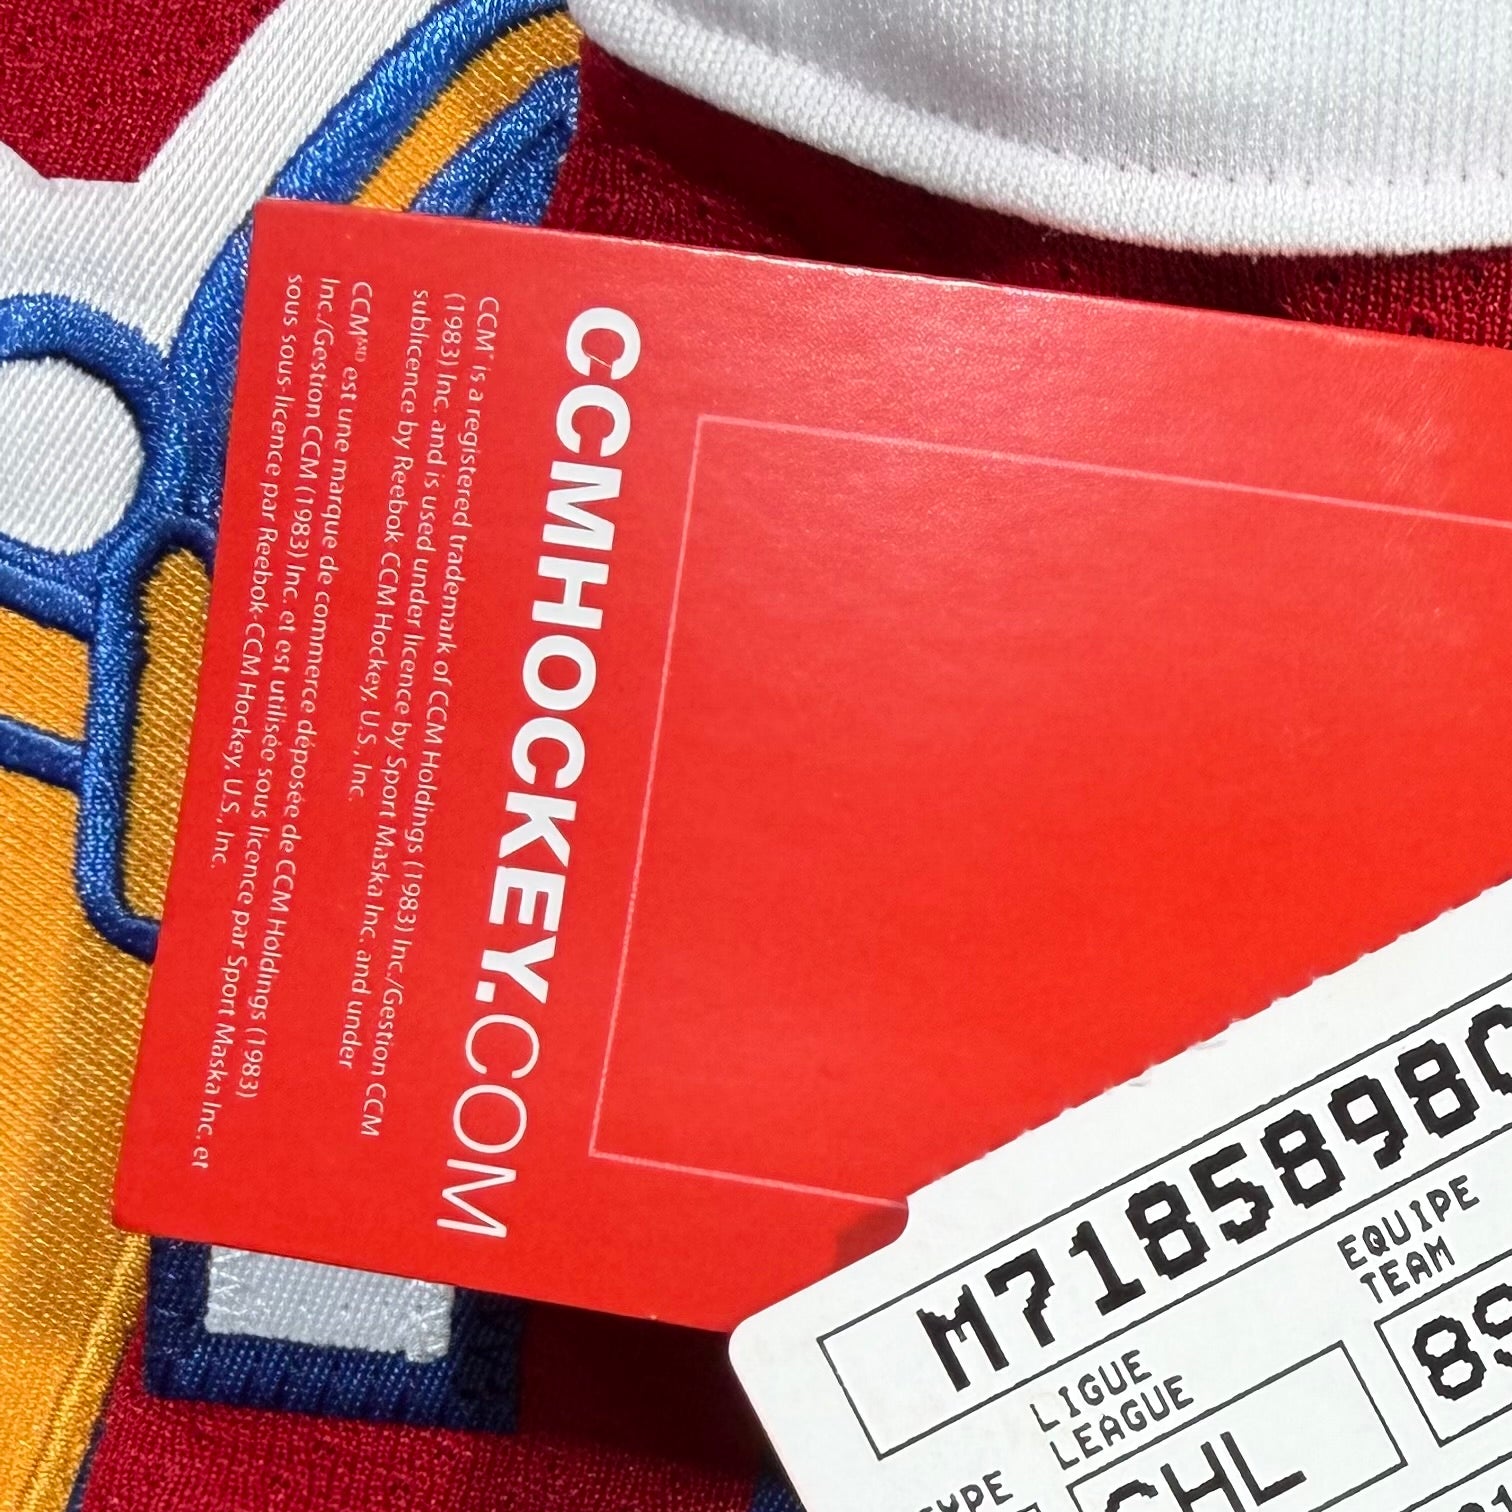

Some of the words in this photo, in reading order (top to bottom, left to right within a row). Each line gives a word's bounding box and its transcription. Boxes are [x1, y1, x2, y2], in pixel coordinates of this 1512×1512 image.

[282, 274, 302, 326] sous
[436, 293, 465, 366] (1983)
[304, 277, 340, 418] Inc./Gestion
[400, 290, 431, 413] sublicence
[469, 365, 490, 382] is
[339, 366, 357, 400] est
[432, 373, 457, 413] Inc.
[468, 388, 483, 401] a
[298, 425, 323, 479] CCM
[333, 408, 352, 452] une
[390, 420, 419, 449] by
[426, 419, 447, 465] and
[423, 471, 444, 488] is
[451, 408, 480, 527] registered
[258, 482, 278, 521] par
[285, 485, 316, 558] (1983)
[319, 458, 346, 549] marque
[383, 455, 413, 542] Reebok
[415, 495, 436, 551] used
[282, 564, 305, 603] Inc.
[316, 555, 339, 585] de
[375, 551, 400, 606] CCM
[406, 558, 429, 628] under
[435, 534, 467, 653] trademark
[239, 527, 278, 675] Reebok-CCM
[277, 610, 295, 633] et
[271, 639, 291, 673] est
[299, 591, 329, 713] commerce
[358, 612, 393, 701] Hockey,
[394, 633, 425, 715] licence
[432, 660, 452, 687] of
[221, 682, 256, 770] Hockey,
[259, 679, 287, 761] utilisée
[384, 721, 411, 750] by
[423, 690, 448, 744] CCM
[250, 768, 272, 818] sous
[283, 719, 317, 818] déposée
[348, 763, 372, 801] Inc.
[378, 755, 406, 818] Sport
[435, 306, 640, 1238] CCMHOCKEY.COM
[403, 750, 441, 853] Holdings
[210, 830, 235, 868] Inc.
[236, 825, 269, 904] licence
[278, 823, 301, 853] de
[366, 824, 396, 897] Maska
[269, 859, 296, 912] CCM
[393, 860, 424, 932] (1983)
[230, 909, 249, 949] par
[358, 903, 384, 942] Inc.
[217, 955, 247, 1016] Sport
[247, 918, 286, 1020] Holdings
[351, 949, 371, 994] and
[338, 1000, 362, 1069] under
[369, 938, 412, 1075] Inc./Gestion
[203, 1022, 235, 1094] Maska
[234, 1027, 267, 1098] (1983)
[195, 1101, 222, 1139] Inc.
[359, 1082, 386, 1136] CCM
[191, 1146, 208, 1169] et
[1337, 1175, 1479, 1270] EQUIPE
[1360, 1235, 1455, 1303] TEAM
[1030, 1349, 1152, 1432] LIGUE
[1050, 1375, 1193, 1470] LEAGUE
